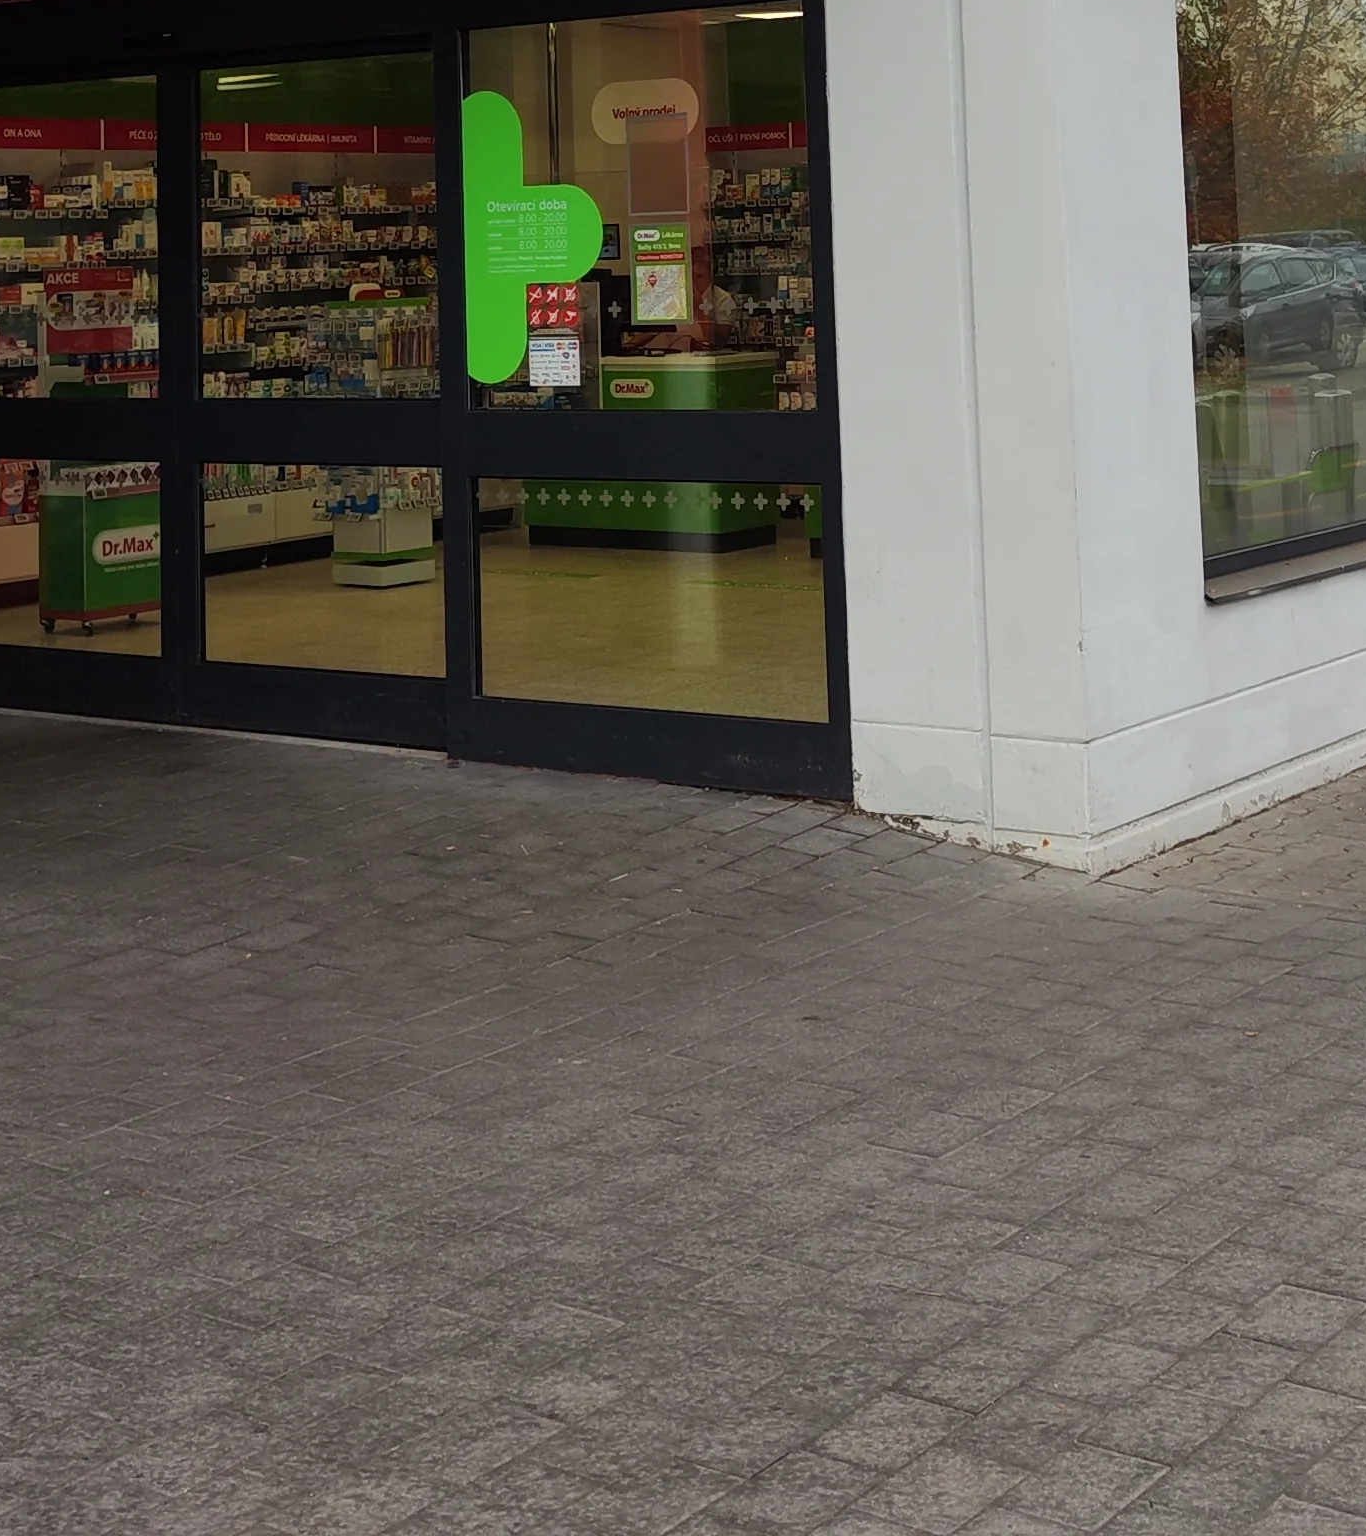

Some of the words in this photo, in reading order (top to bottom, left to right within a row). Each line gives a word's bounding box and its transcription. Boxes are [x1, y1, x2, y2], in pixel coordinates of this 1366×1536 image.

[2, 128, 17, 138] ON
[538, 198, 567, 211] doba
[45, 271, 80, 285] AKCE
[614, 382, 646, 394] Dr.Max
[102, 536, 154, 557] Dr.Max
